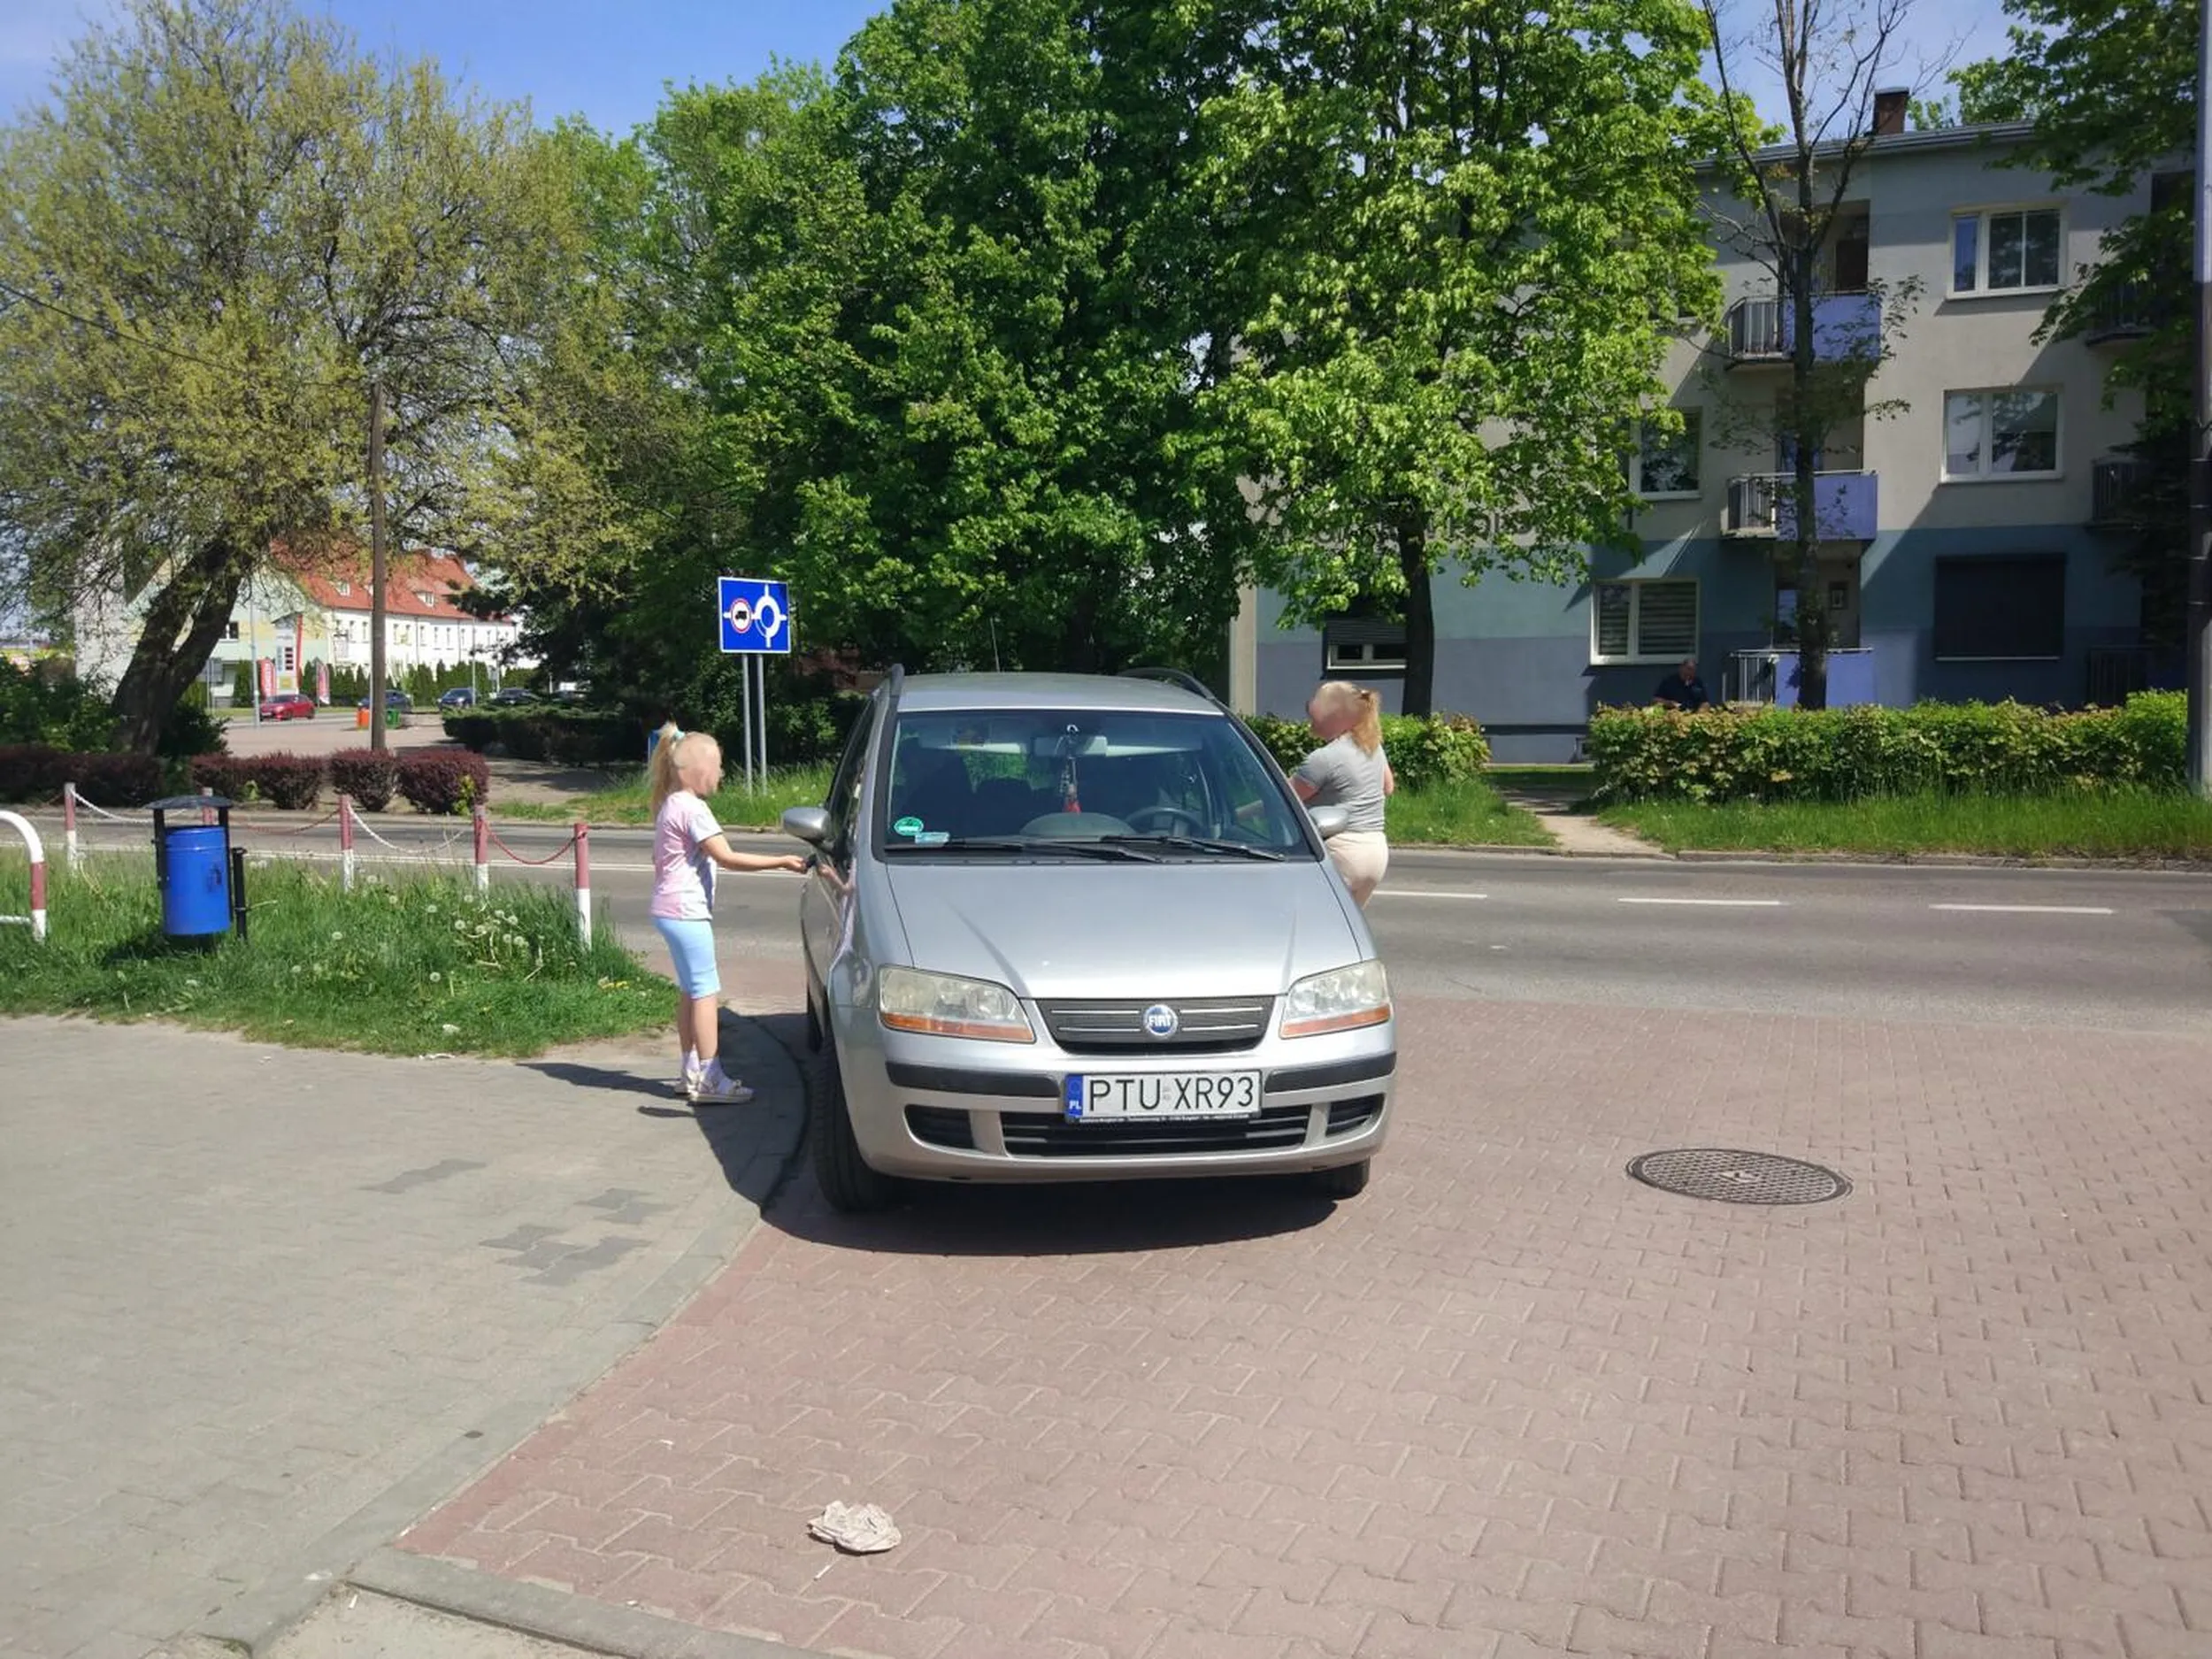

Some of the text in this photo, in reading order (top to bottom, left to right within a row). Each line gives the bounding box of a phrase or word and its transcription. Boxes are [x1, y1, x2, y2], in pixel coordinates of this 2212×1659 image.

[1148, 1014, 1171, 1027] FIAT
[1089, 1076, 1254, 1111] PTU XR93
[1069, 1100, 1082, 1110] PL
